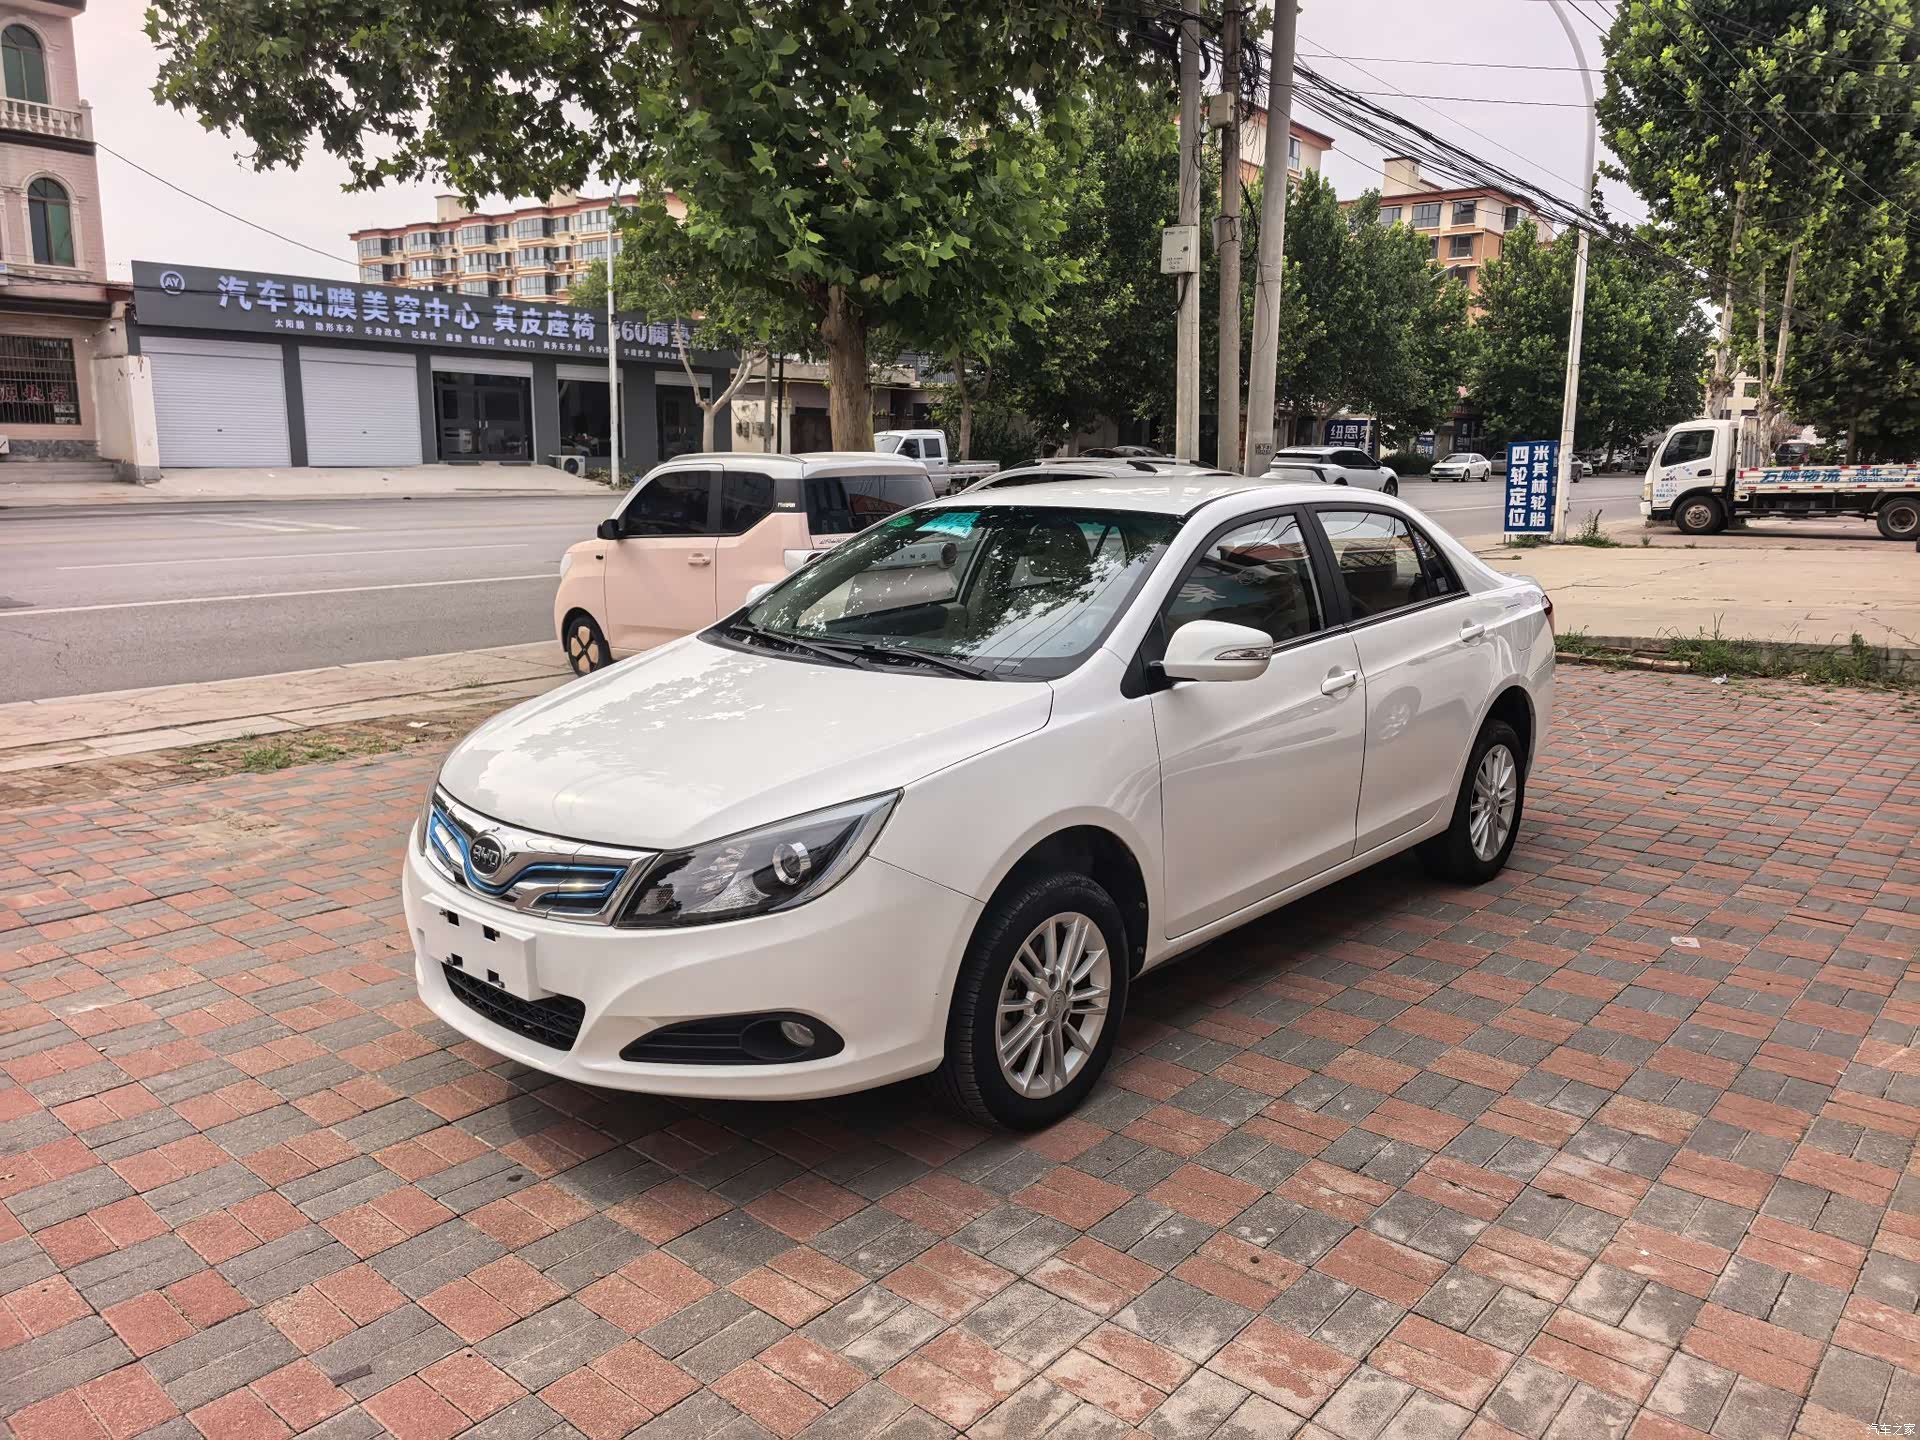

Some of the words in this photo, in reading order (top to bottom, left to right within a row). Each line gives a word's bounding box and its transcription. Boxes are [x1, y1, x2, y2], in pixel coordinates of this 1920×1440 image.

[217, 275, 480, 331] 汽车贴膜美容中心
[492, 304, 596, 341] 真皮座椅
[613, 320, 702, 349] 360脚垫
[275, 319, 305, 330] 太阳膜
[315, 322, 354, 333] 隐形车衣
[364, 326, 402, 338] 车身改色
[411, 330, 437, 341] 记录仪
[1508, 446, 1530, 527] 四轮定位
[1529, 445, 1550, 527] 米其林轮胎
[472, 844, 500, 868] BYD
